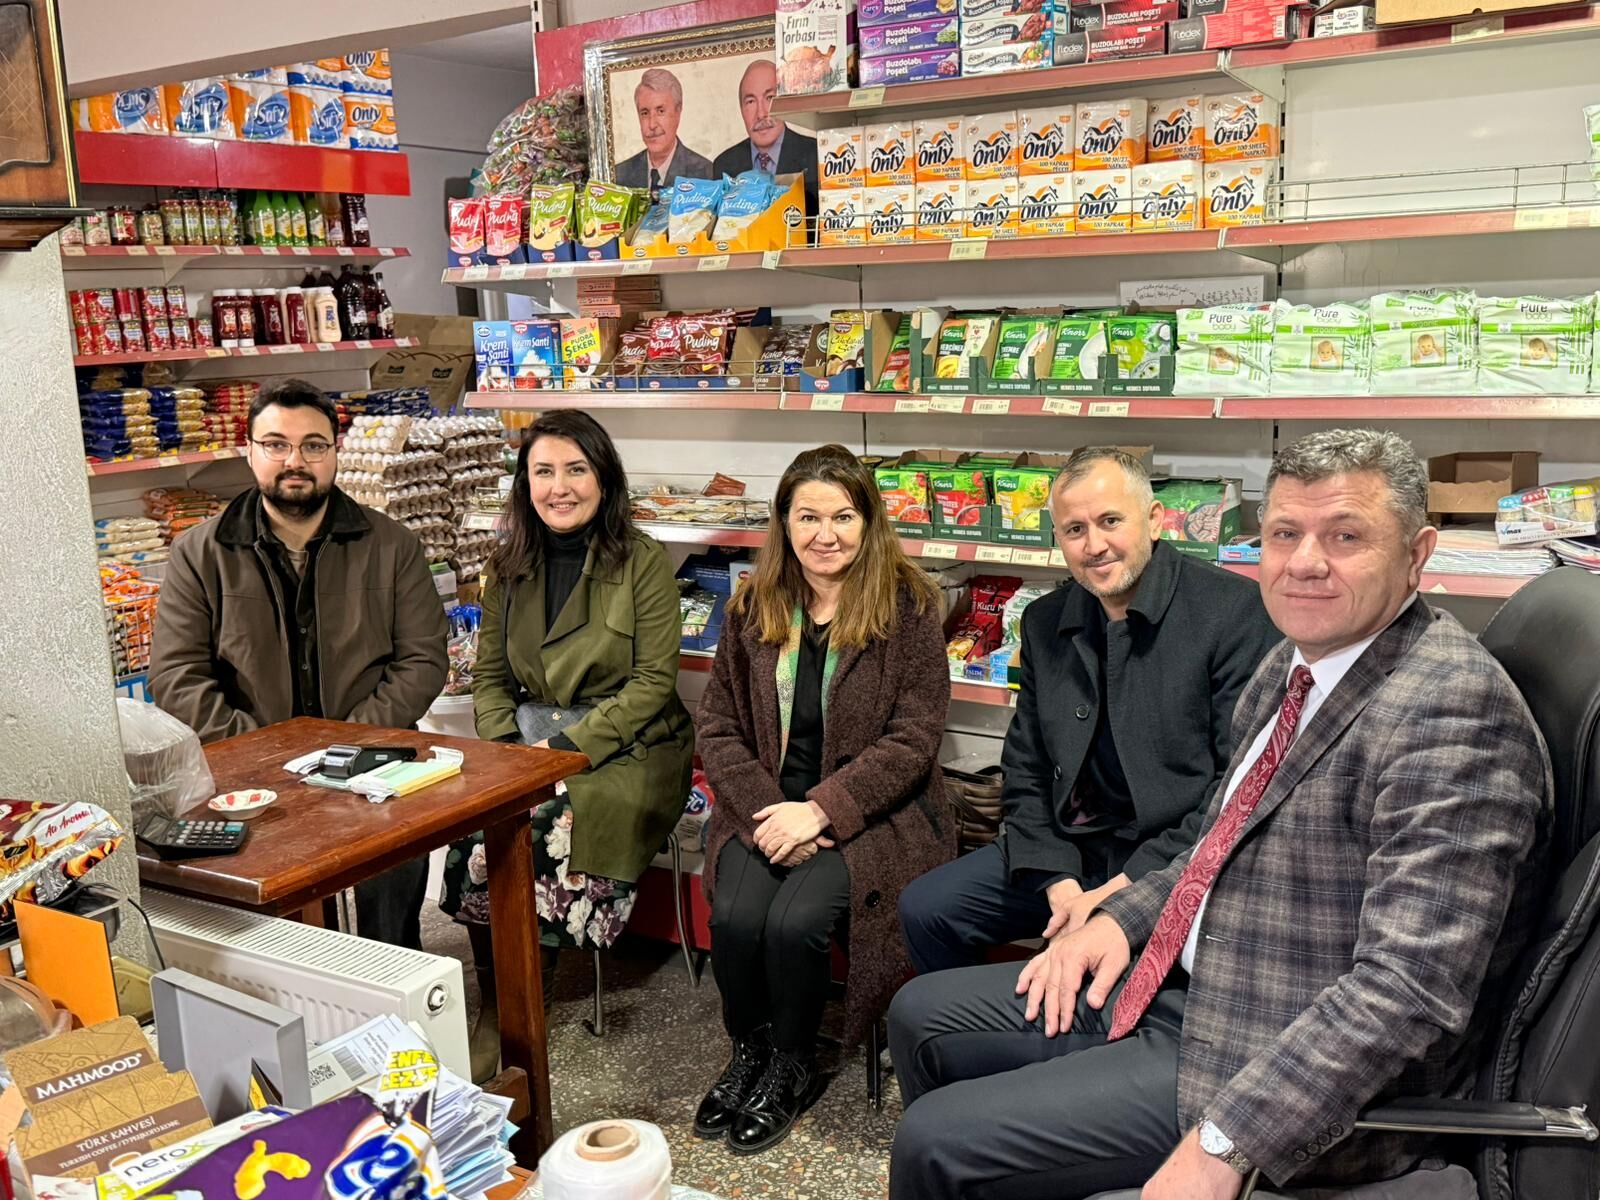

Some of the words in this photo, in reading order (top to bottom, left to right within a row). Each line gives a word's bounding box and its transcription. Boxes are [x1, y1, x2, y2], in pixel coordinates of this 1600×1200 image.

[352, 106, 381, 122] Only
[1152, 126, 1192, 148] Only
[1214, 121, 1258, 146] Only
[1023, 138, 1063, 160] Only
[1082, 134, 1122, 154] Only
[871, 153, 905, 174] Only
[918, 148, 954, 168] Only
[972, 146, 1011, 168] Only
[824, 158, 856, 178] Only
[588, 197, 622, 218] Puding
[1021, 201, 1058, 222] Only
[1078, 199, 1118, 220] Only
[1210, 193, 1254, 214] Only
[871, 216, 905, 236] Only
[1209, 314, 1233, 324] Pure
[1314, 308, 1338, 318] Pure
[570, 332, 594, 345] PUDRA
[943, 329, 964, 338] Knorr
[1004, 330, 1026, 339] Knorr
[1062, 328, 1086, 336] Knorr
[1112, 327, 1134, 336] Knorr
[480, 340, 508, 353] Krem
[684, 334, 720, 350] Puding
[762, 351, 783, 360] Kaka
[878, 480, 898, 488] Knorr
[934, 480, 952, 488] Knorr
[998, 479, 1017, 489] Knorr
[977, 601, 996, 612] Kuru
[387, 1049, 438, 1069] ENFE
[36, 1054, 141, 1100] MAHMOOD
[76, 1134, 109, 1152] TÜRK
[110, 1116, 156, 1140] KAHVESİ
